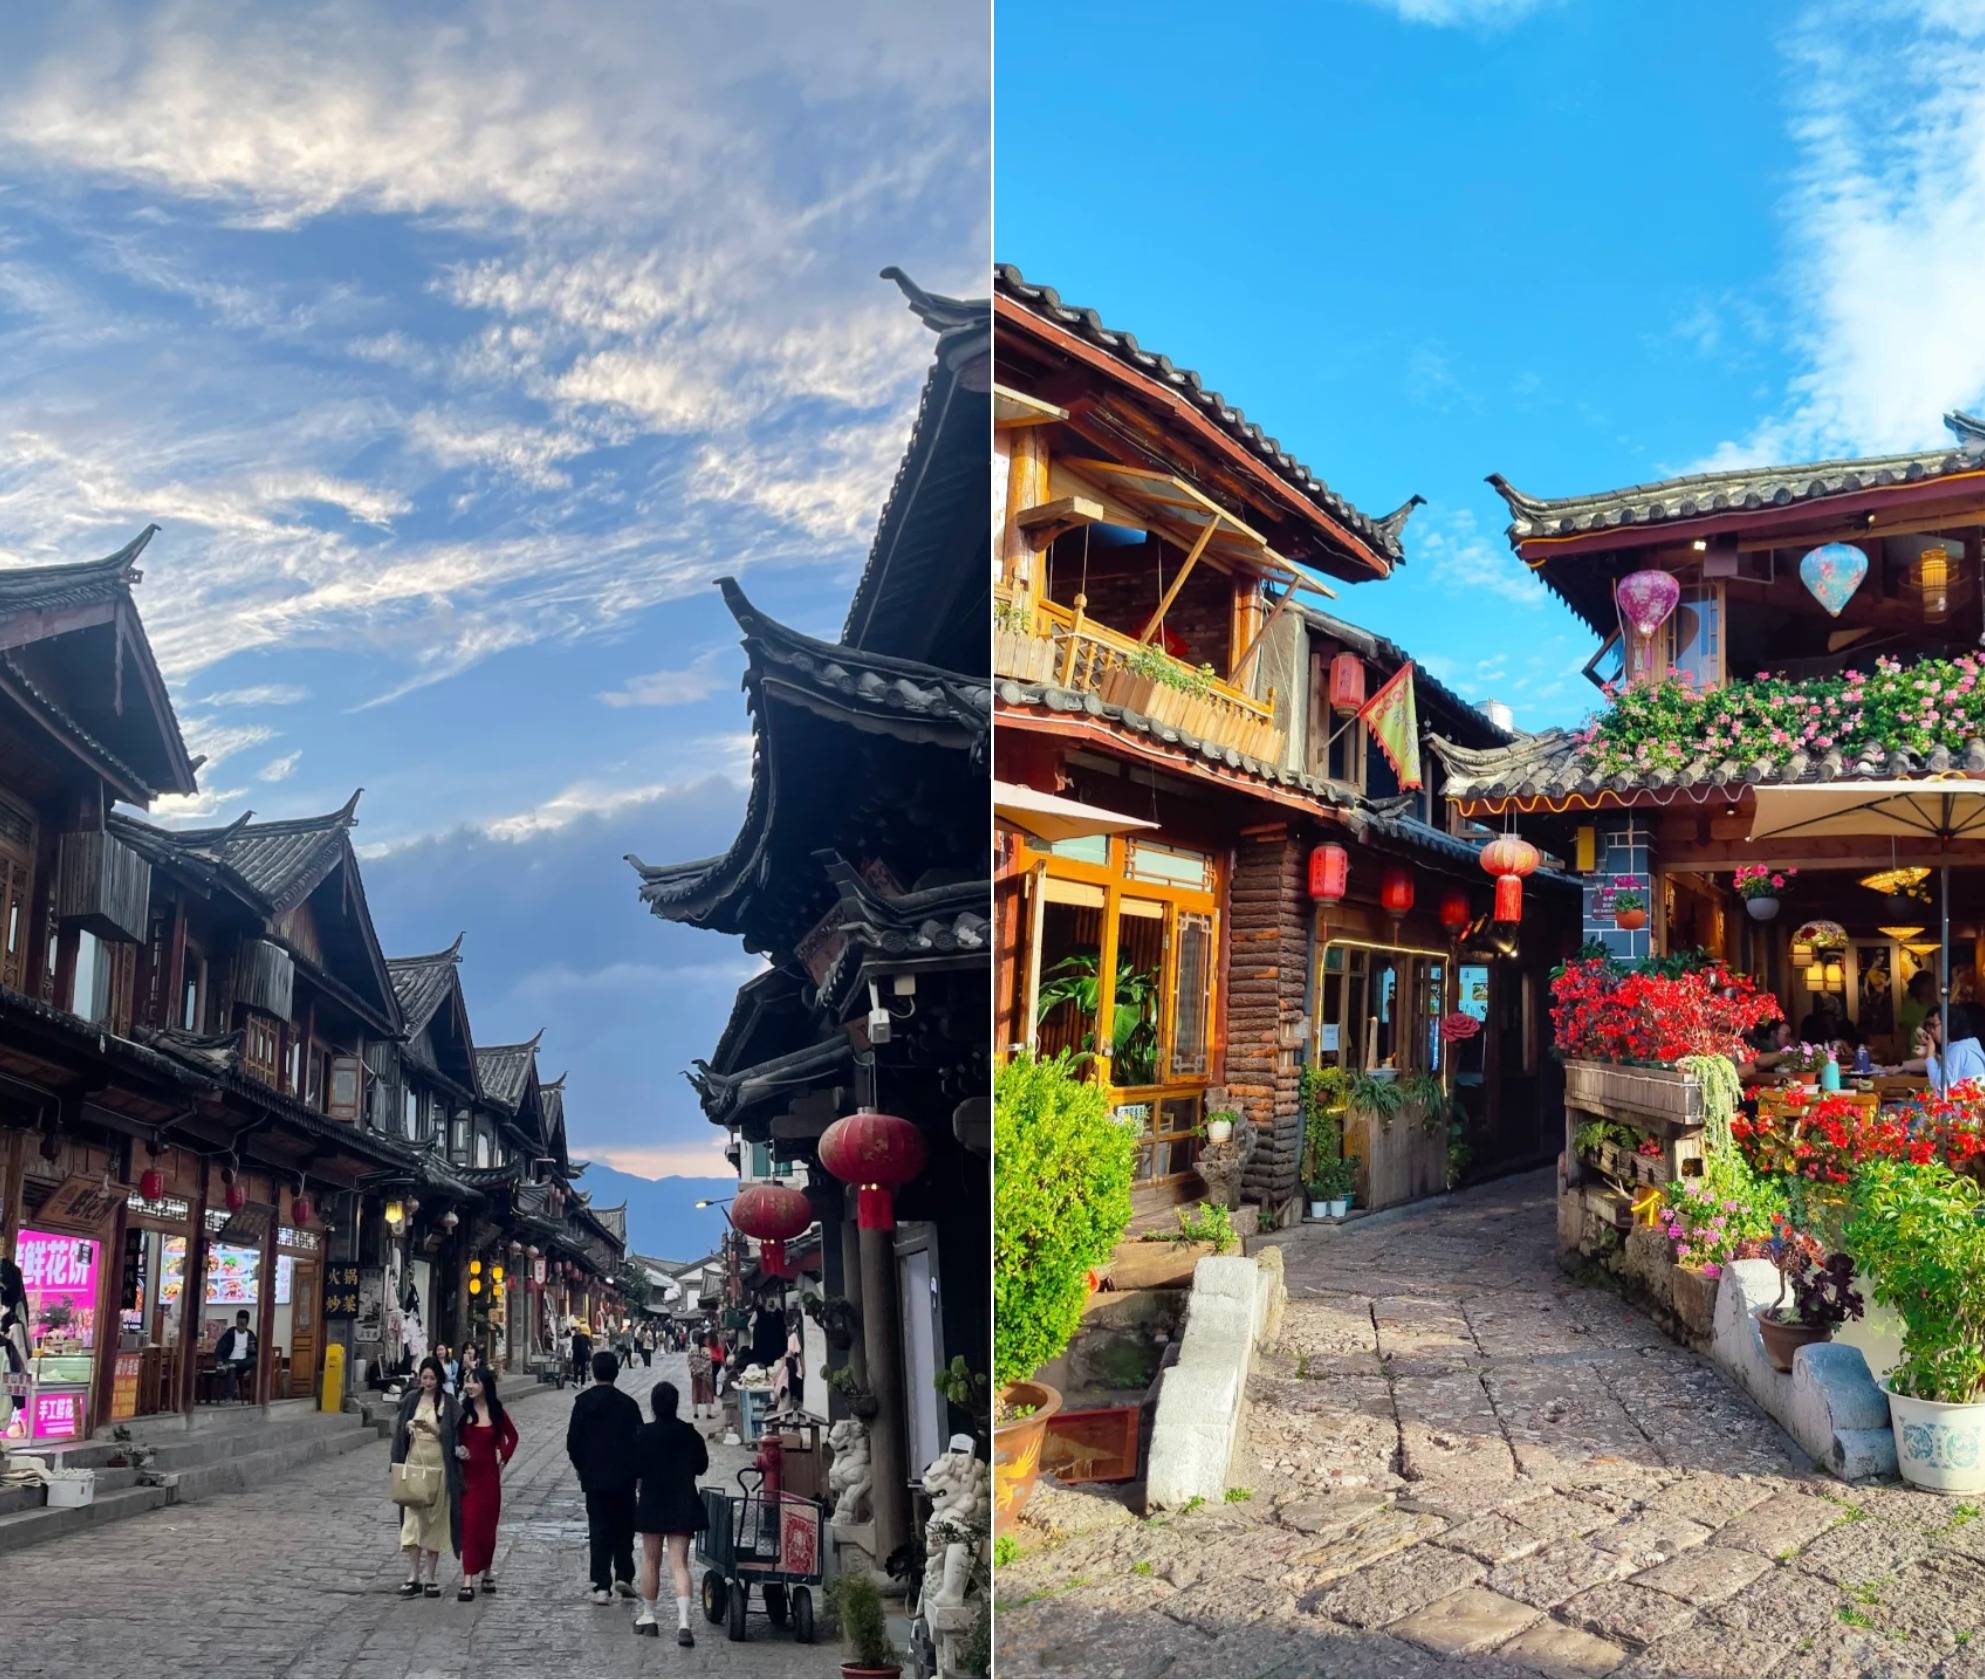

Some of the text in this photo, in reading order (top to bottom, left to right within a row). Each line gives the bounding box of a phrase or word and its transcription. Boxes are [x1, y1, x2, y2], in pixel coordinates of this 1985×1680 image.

[328, 1267, 358, 1286] 火锅
[38, 1397, 82, 1421] 手工鲜花
